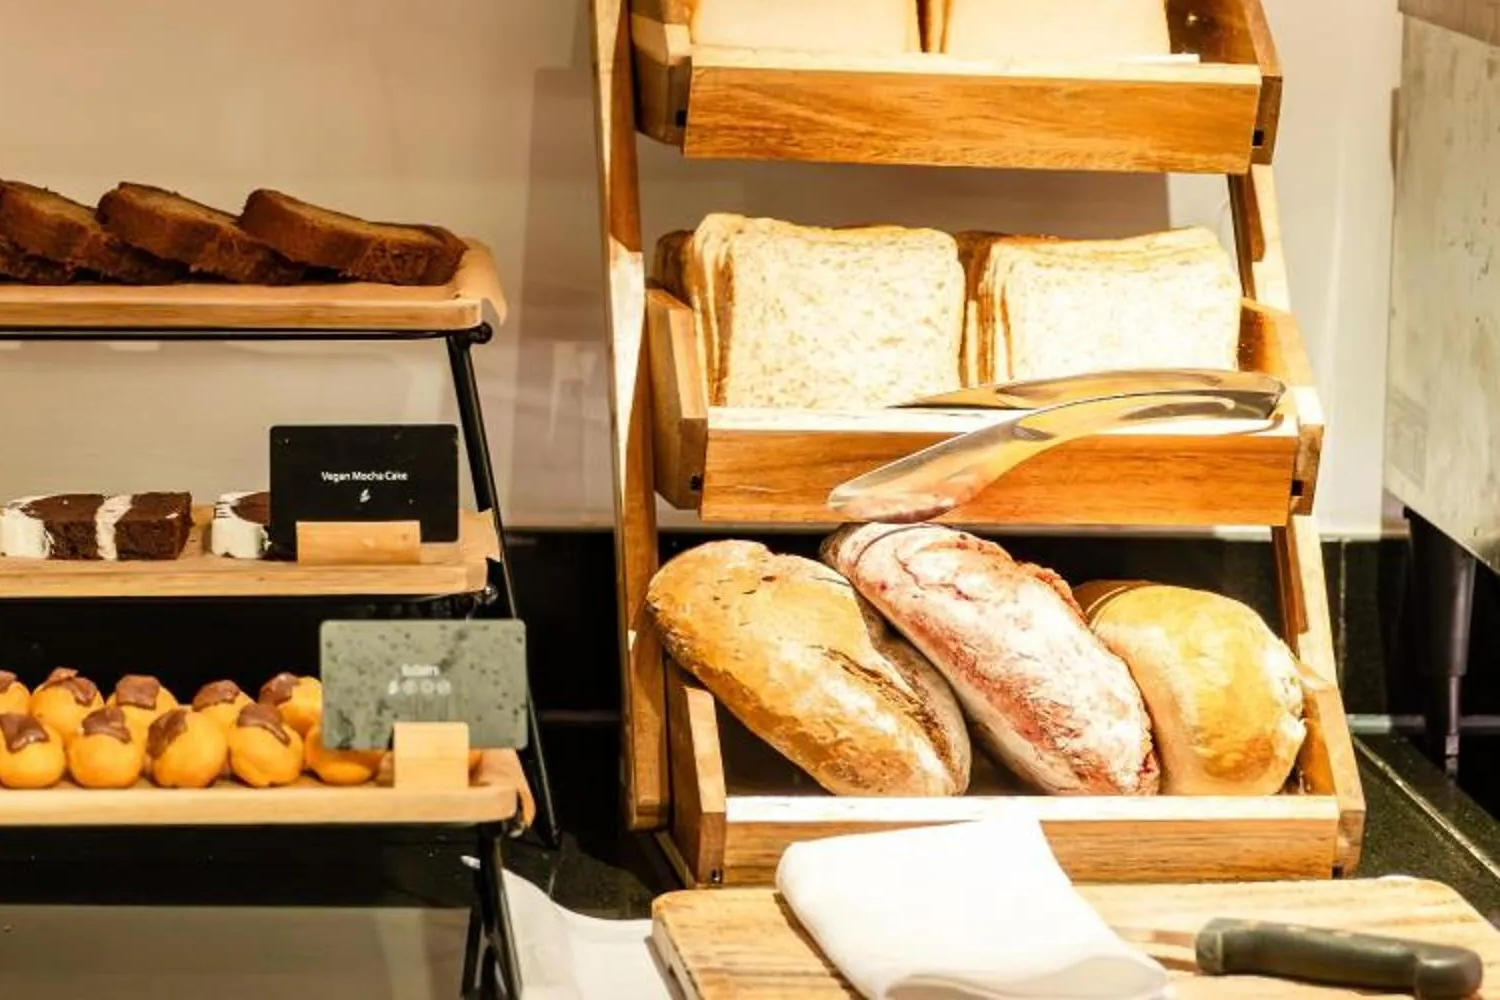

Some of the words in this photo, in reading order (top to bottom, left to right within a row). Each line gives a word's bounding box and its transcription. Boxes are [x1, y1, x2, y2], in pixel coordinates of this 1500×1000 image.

[321, 471, 351, 483] Vegan
[351, 471, 384, 481] Mocha
[385, 471, 408, 481] Cake
